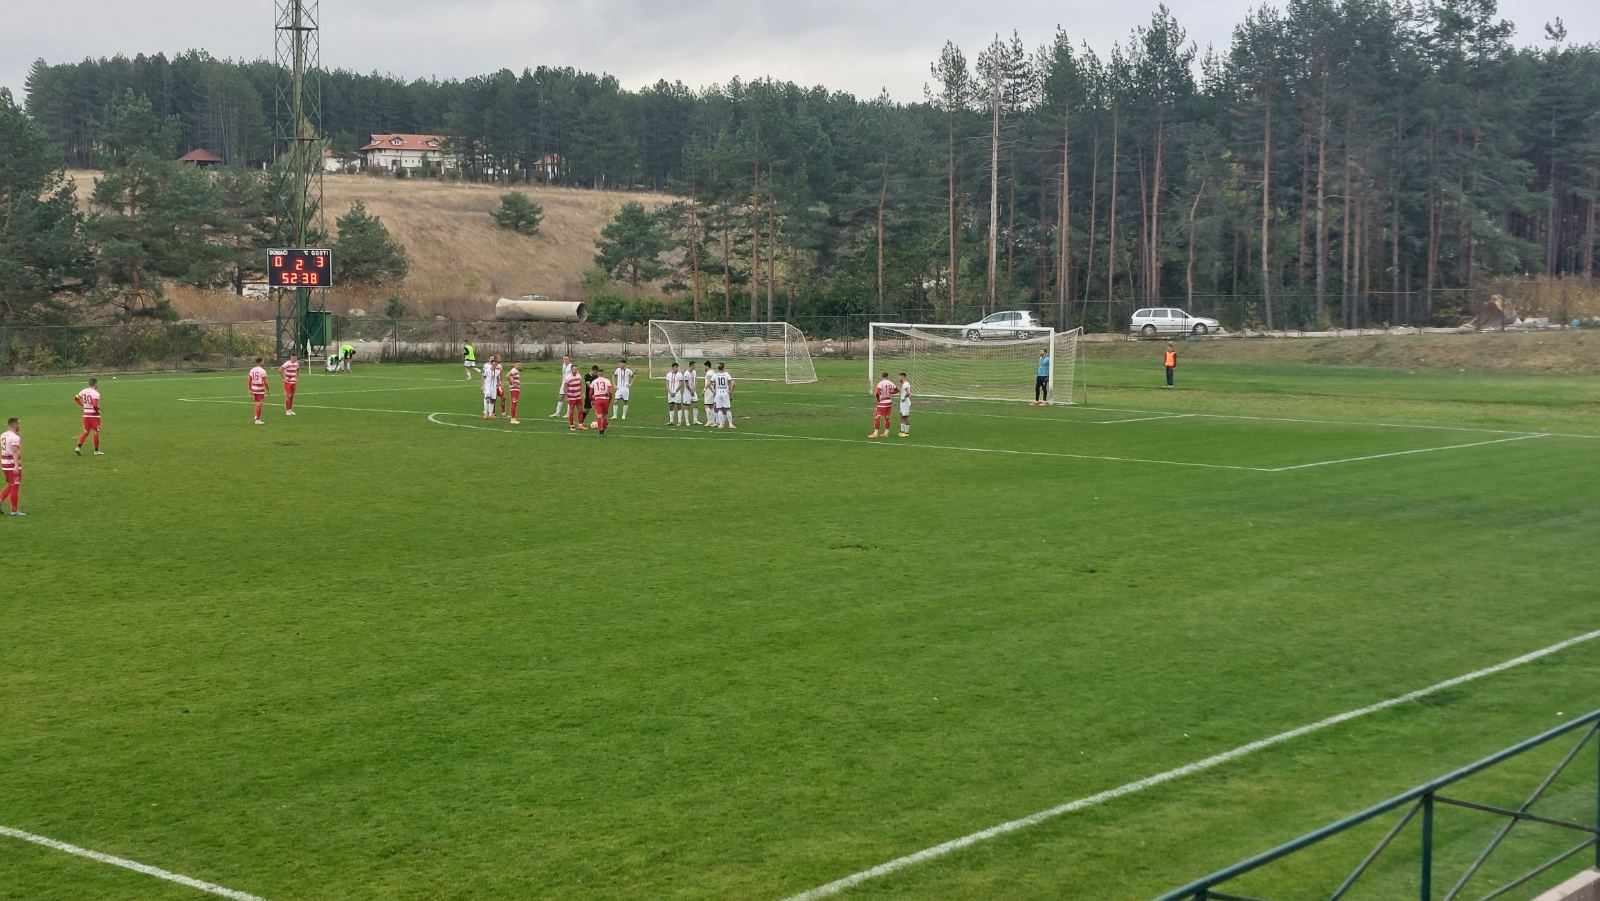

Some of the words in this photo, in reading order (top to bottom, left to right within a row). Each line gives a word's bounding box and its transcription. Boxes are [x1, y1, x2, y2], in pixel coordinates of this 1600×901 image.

[274, 256, 282, 267] 0
[295, 259, 303, 271] 2
[315, 256, 324, 268] 3
[282, 272, 318, 284] 52:38
[596, 381, 606, 391] 13
[718, 376, 726, 386] 10
